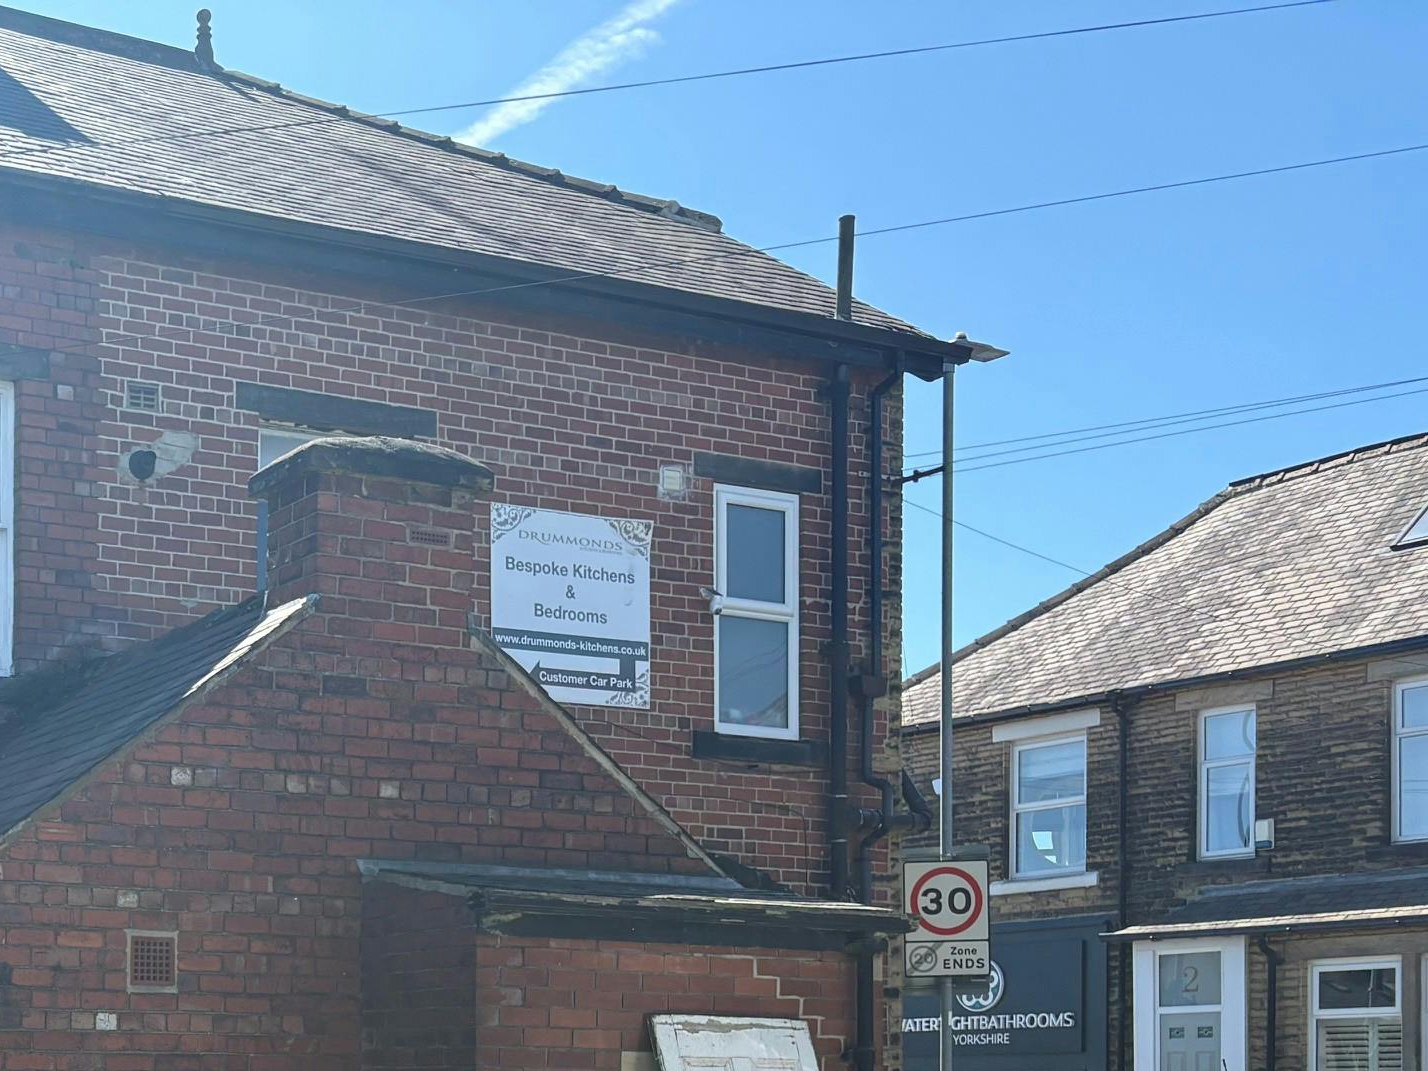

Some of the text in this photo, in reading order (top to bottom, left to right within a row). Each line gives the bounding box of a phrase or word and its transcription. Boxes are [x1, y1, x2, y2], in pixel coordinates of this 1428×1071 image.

[518, 529, 623, 551] DRUMMONDS
[505, 556, 635, 584] Bespoke Kitchens
[565, 584, 576, 599] &
[534, 603, 608, 624] Bedrooms
[494, 634, 647, 657] www.drummonds-kitchens.co.uk
[539, 670, 633, 689] Customer Car Park
[921, 887, 972, 915] 30
[913, 952, 934, 966] 20
[950, 946, 978, 955] Zone
[943, 958, 985, 969] ENDS
[1181, 966, 1199, 992] 2
[901, 1012, 1075, 1033] ATERGHTBATHROOMS
[952, 1033, 1010, 1046] YORKSHIRE
